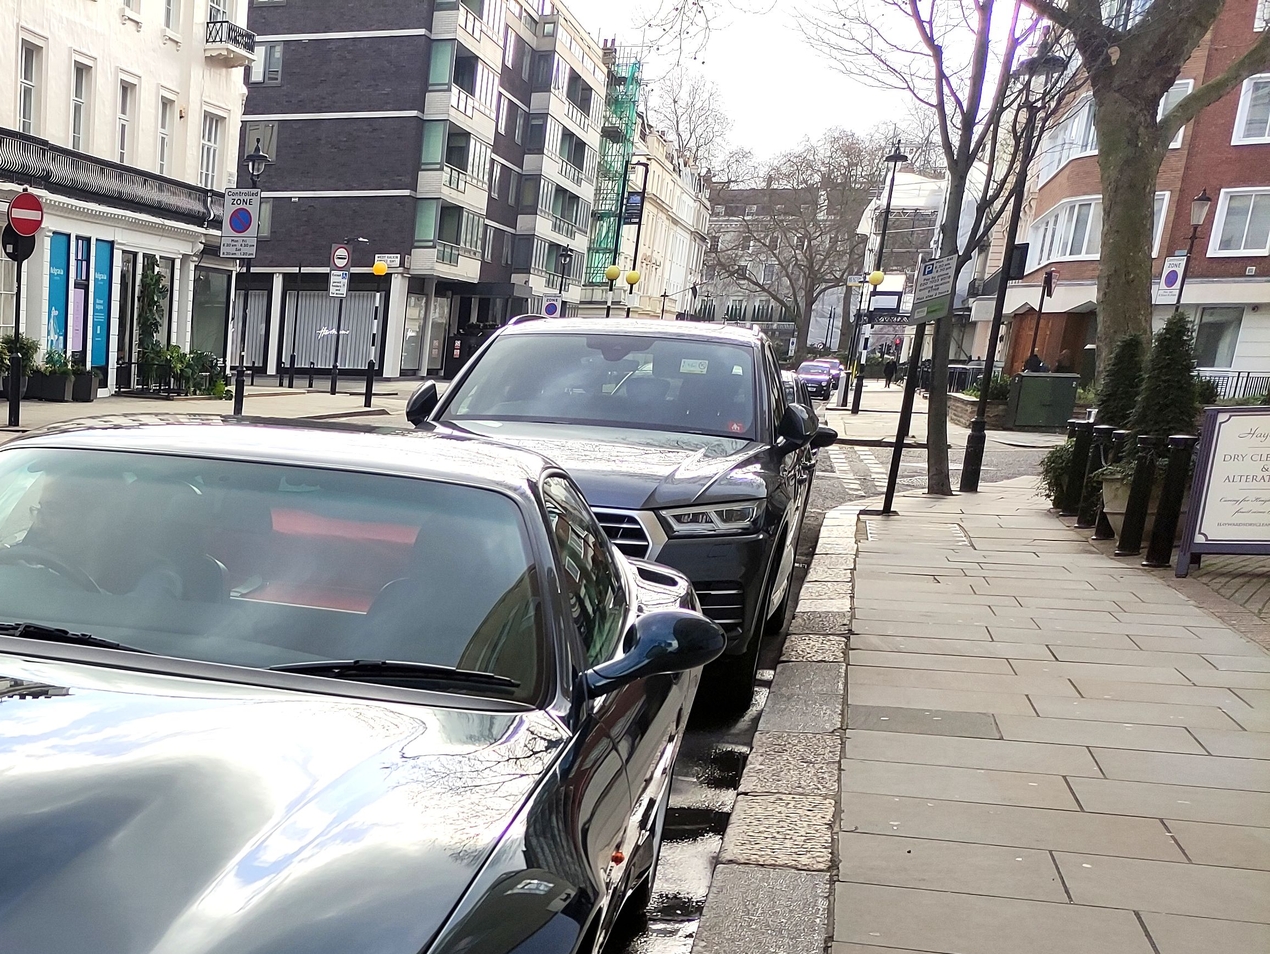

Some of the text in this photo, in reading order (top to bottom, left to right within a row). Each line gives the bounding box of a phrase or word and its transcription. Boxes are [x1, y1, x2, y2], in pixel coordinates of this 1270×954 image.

[1238, 426, 1270, 442] Hay
[1223, 454, 1248, 462] DRY
[1260, 464, 1270, 472] &
